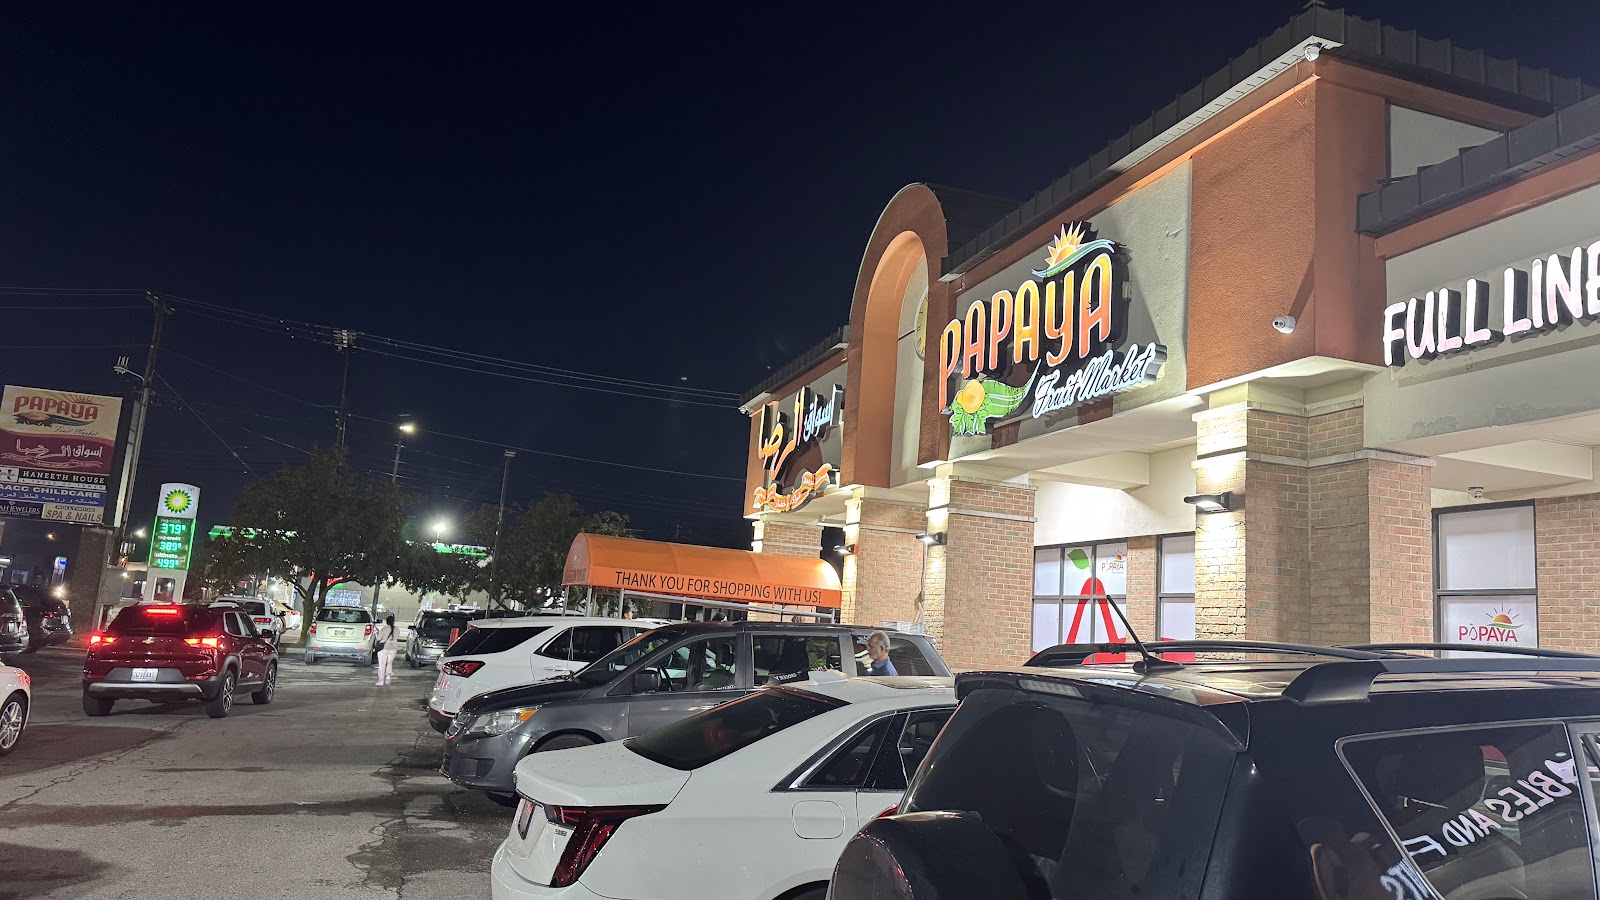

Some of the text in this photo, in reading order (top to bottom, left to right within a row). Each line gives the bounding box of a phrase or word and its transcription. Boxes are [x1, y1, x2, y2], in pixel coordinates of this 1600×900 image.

[938, 252, 1112, 413] PAPAYA
[1383, 278, 1491, 366] FULL
[1033, 342, 1156, 418] Fruit Market
[14, 396, 99, 420] PAPAYA
[23, 470, 69, 481] HANEETH
[72, 475, 105, 484] HOUSE
[33, 487, 101, 498] CHILDCARE
[46, 509, 102, 522] SPA & NAILS
[616, 571, 822, 604] THANK YOU FOR SHOPPING WITH US!
